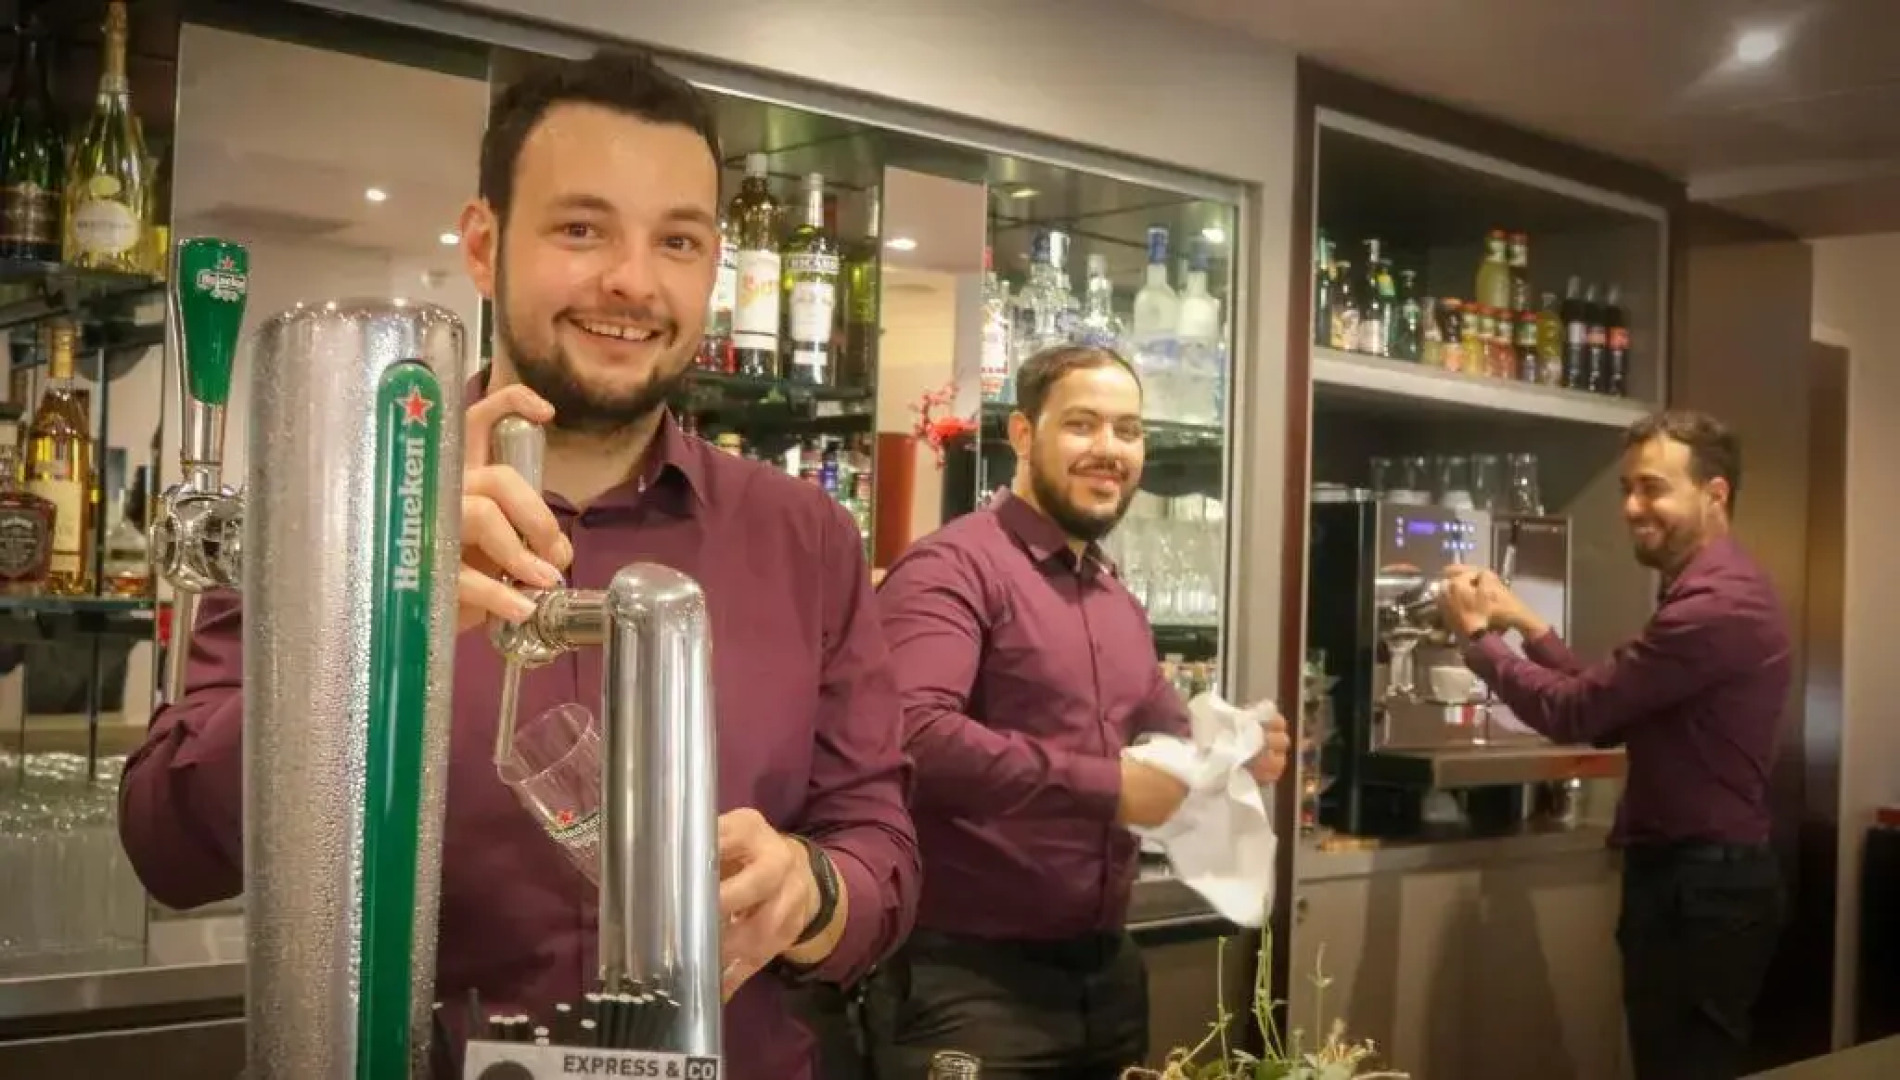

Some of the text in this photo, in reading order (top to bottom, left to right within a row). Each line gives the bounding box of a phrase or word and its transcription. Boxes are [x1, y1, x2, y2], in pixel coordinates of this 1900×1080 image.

[393, 437, 426, 592] Heineken
[563, 1055, 716, 1079] EXPRESS & CO
